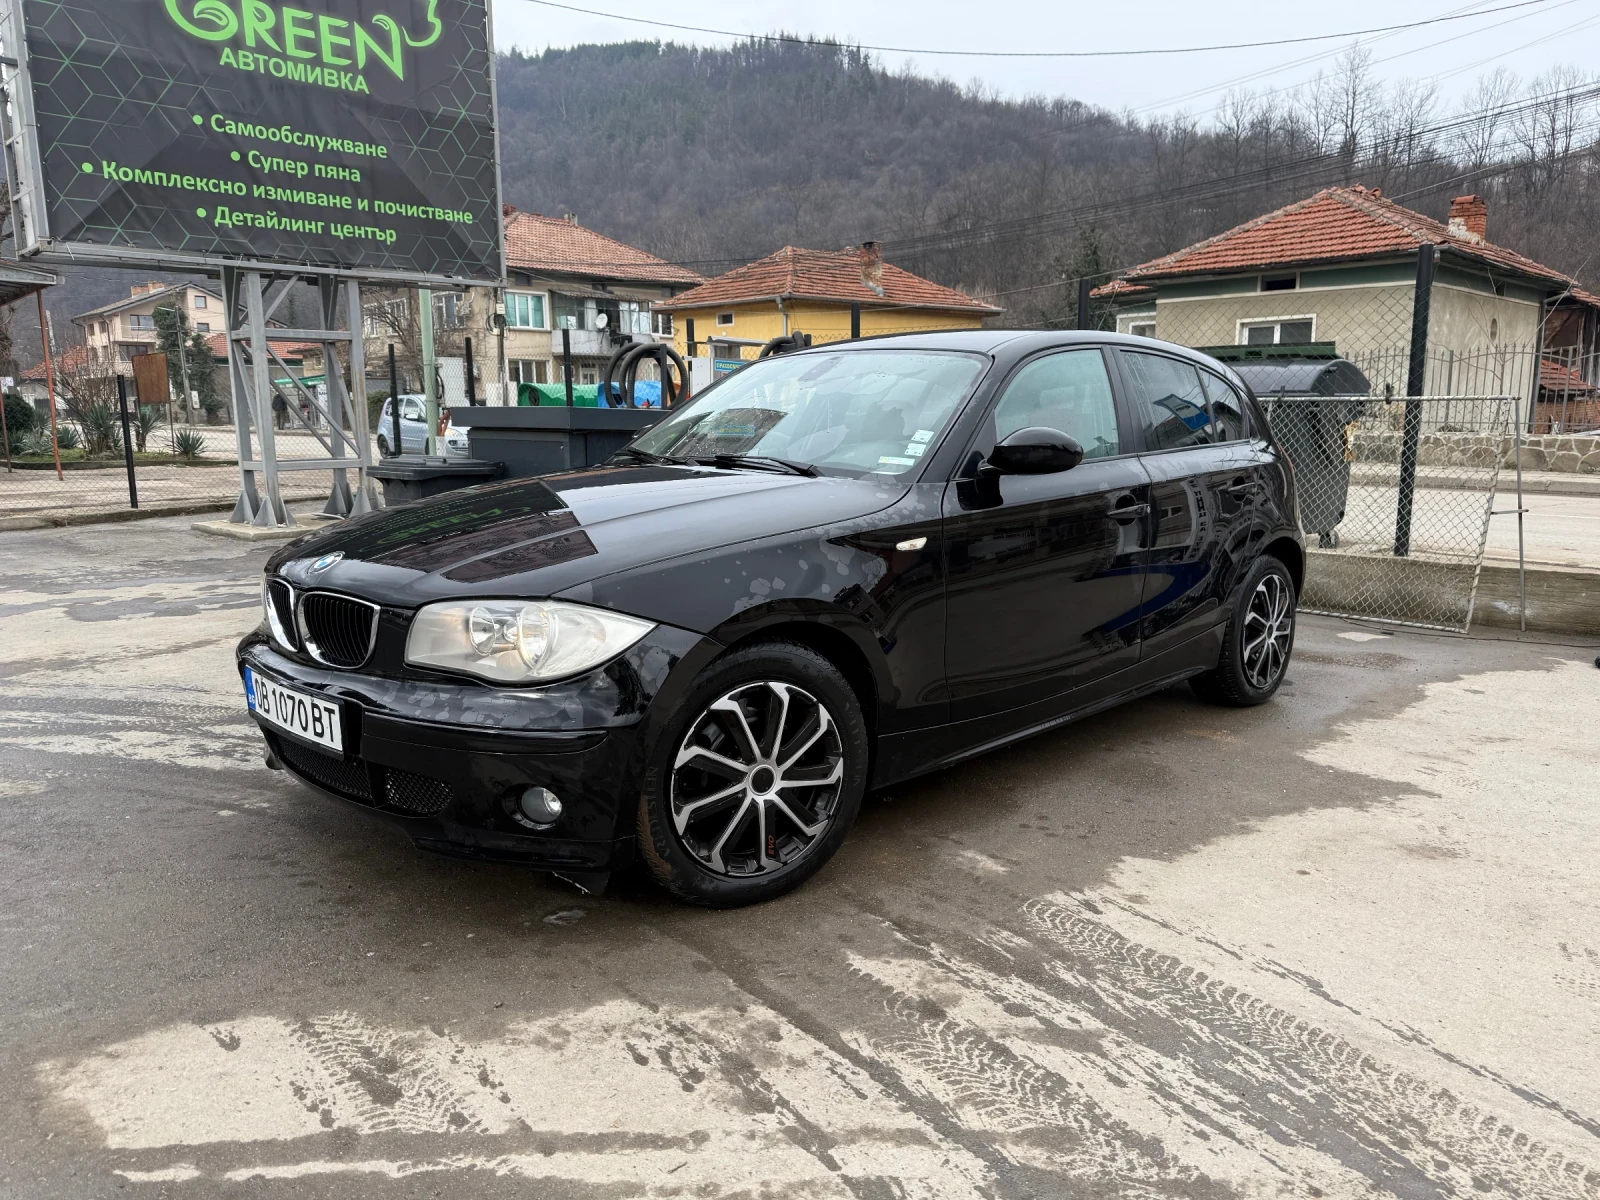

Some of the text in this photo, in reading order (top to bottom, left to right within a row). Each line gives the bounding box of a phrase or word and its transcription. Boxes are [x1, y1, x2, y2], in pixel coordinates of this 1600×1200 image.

[219, 46, 370, 95] АВТОМИВКА
[210, 113, 388, 159] Самообслужване
[247, 149, 361, 183] Супер пяна
[102, 160, 474, 224] Комплексно измиване и почистване
[214, 205, 397, 245] Детайлинг център
[272, 688, 308, 732] 1070
[311, 702, 335, 742] BT
[767, 834, 775, 855] EVO
